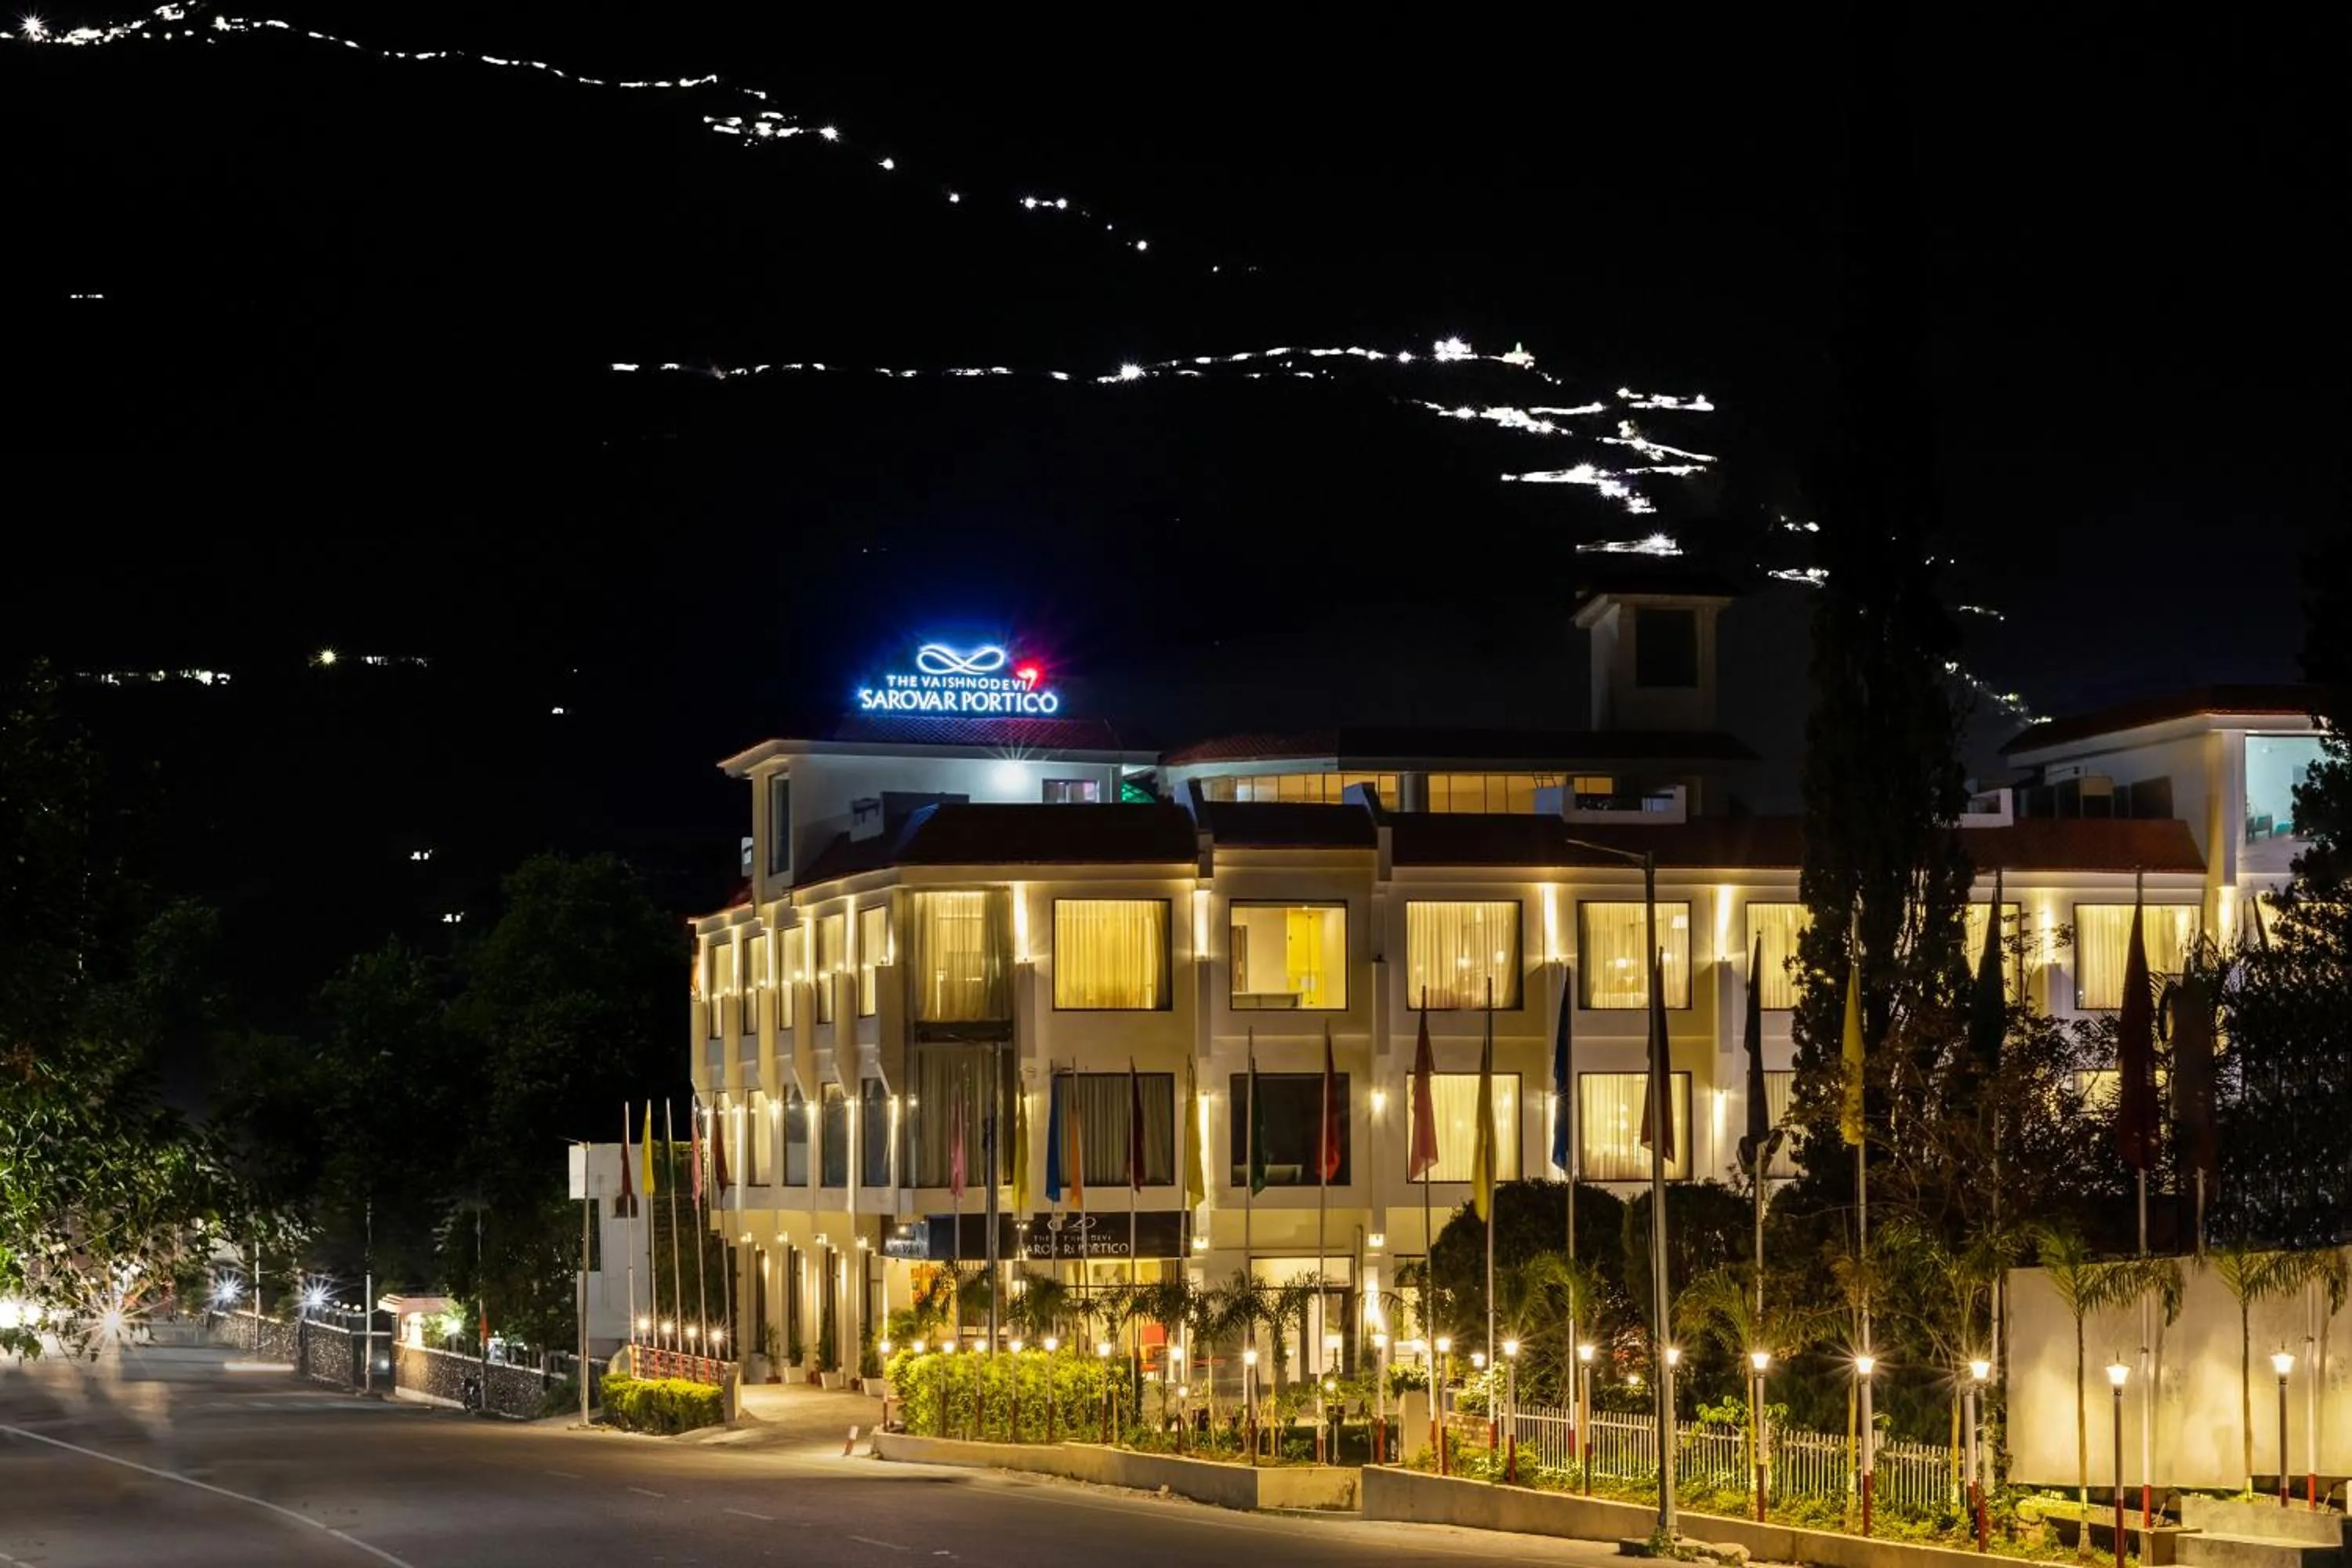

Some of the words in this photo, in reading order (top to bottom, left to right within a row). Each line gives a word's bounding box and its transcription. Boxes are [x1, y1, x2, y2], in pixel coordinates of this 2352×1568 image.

[886, 675, 916, 688] THE
[921, 676, 1026, 691] VAISHNODEVI
[861, 689, 958, 711] SAROVAR
[961, 691, 1058, 713] PORTICO
